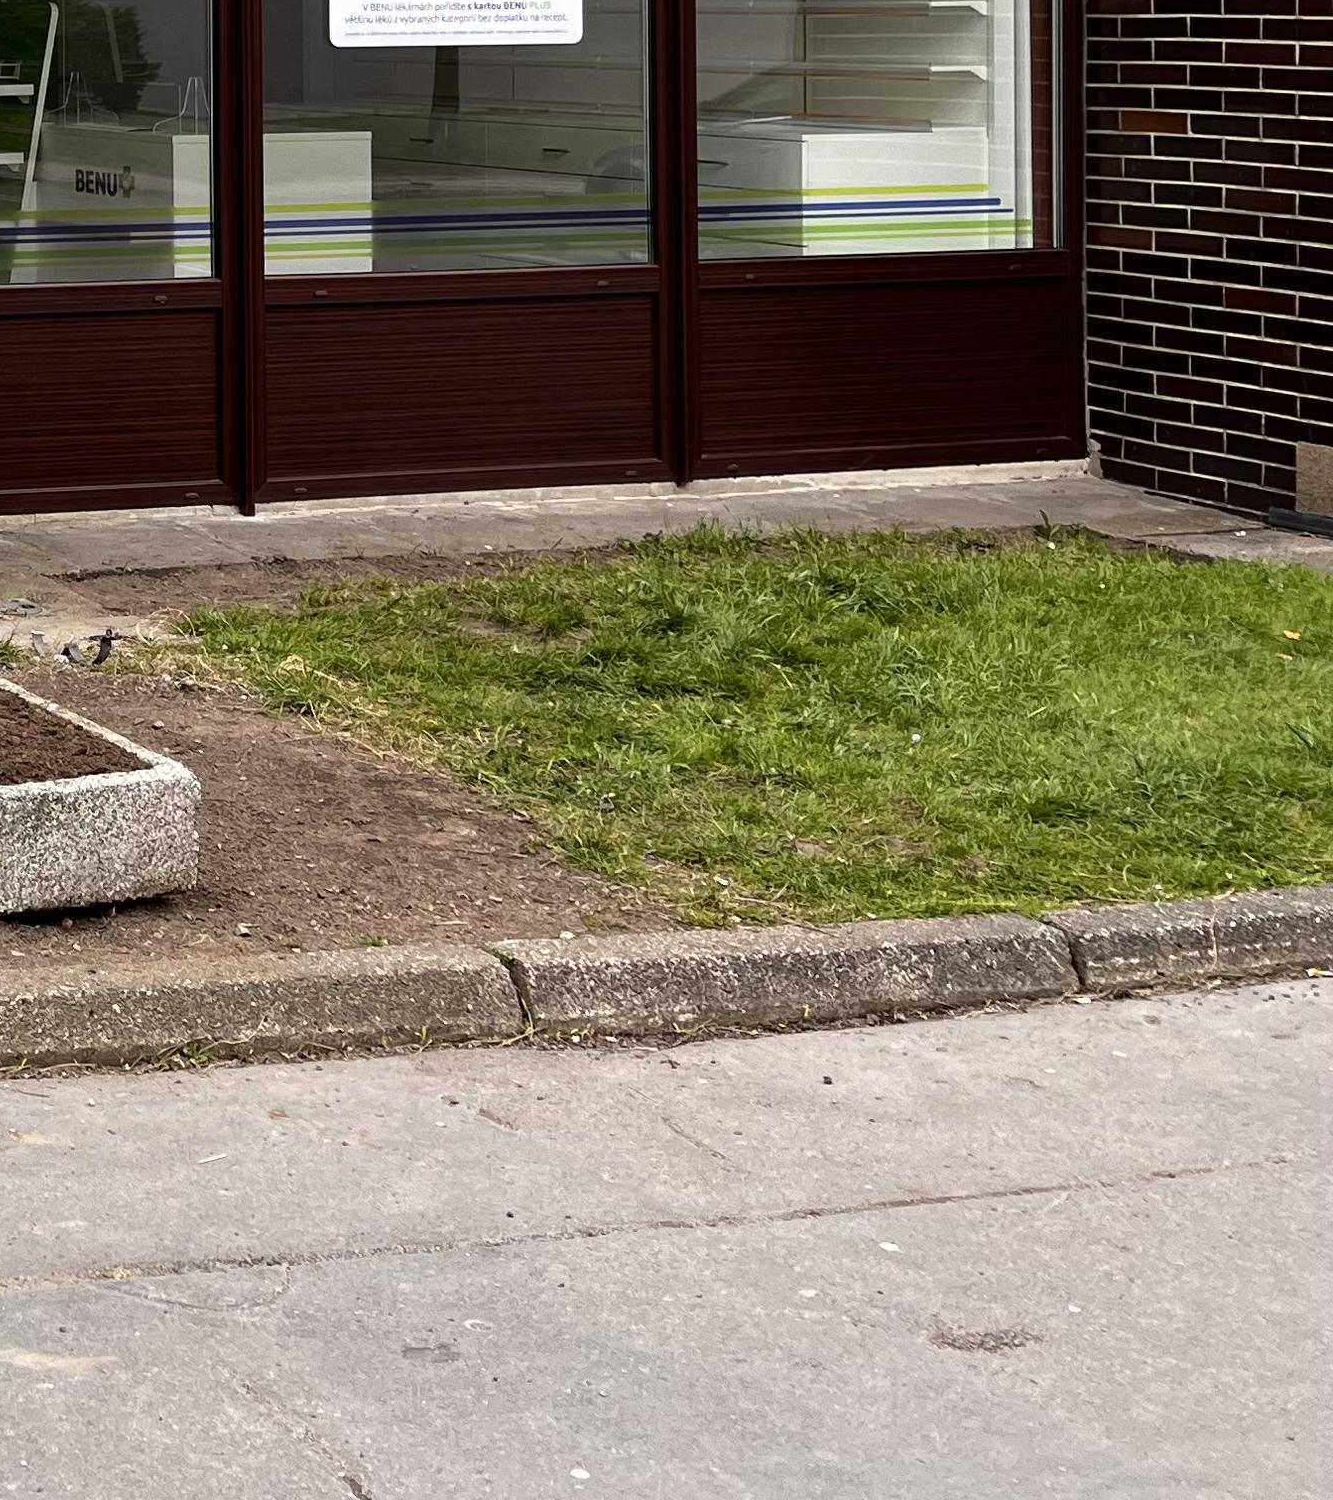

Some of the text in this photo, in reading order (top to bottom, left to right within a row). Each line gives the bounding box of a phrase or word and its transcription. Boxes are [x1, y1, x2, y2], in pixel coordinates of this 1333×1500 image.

[362, 3, 370, 12] V
[370, 3, 393, 12] BENU
[474, 1, 502, 10] kartou
[503, 1, 527, 10] BENU
[478, 13, 492, 23] bez
[74, 168, 118, 197] BENU
